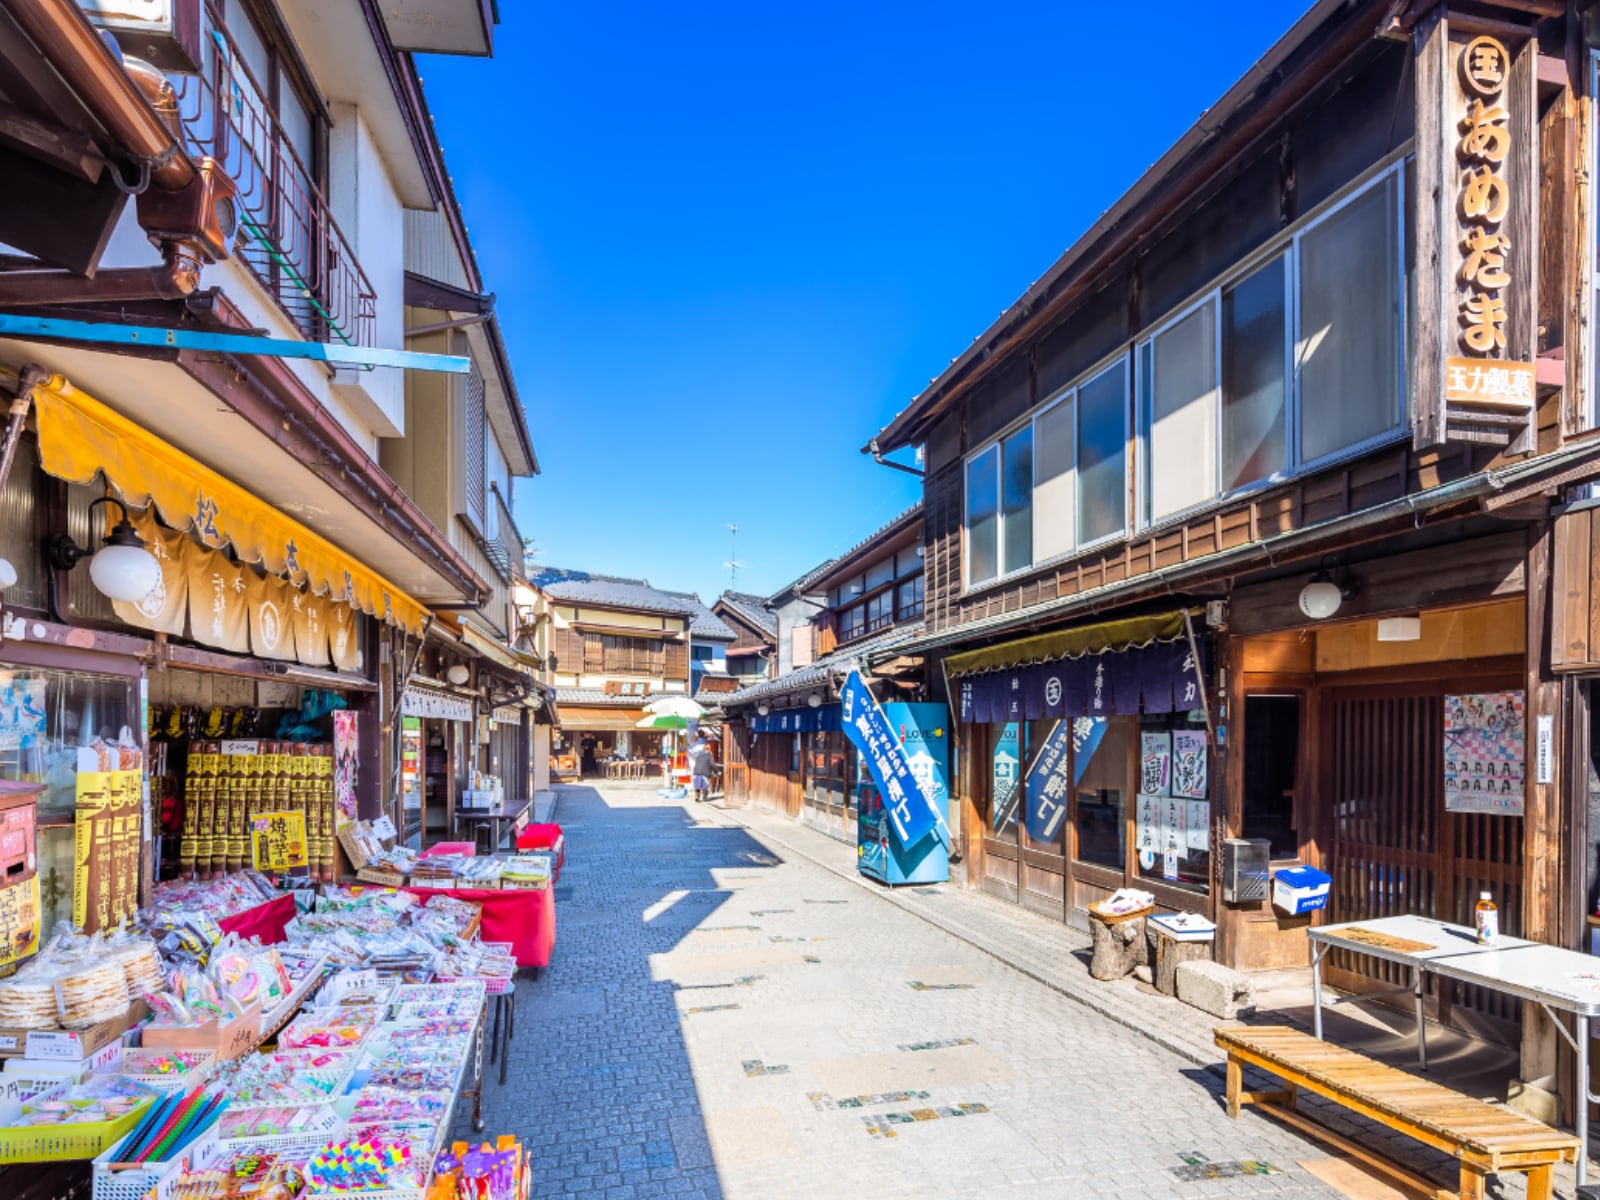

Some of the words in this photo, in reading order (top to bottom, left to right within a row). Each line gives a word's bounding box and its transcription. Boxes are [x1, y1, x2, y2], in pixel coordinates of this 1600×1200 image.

[1462, 98, 1511, 352] あめだま
[1447, 365, 1532, 398] 玉力製菓
[856, 714, 911, 823] 菓子屋横丁
